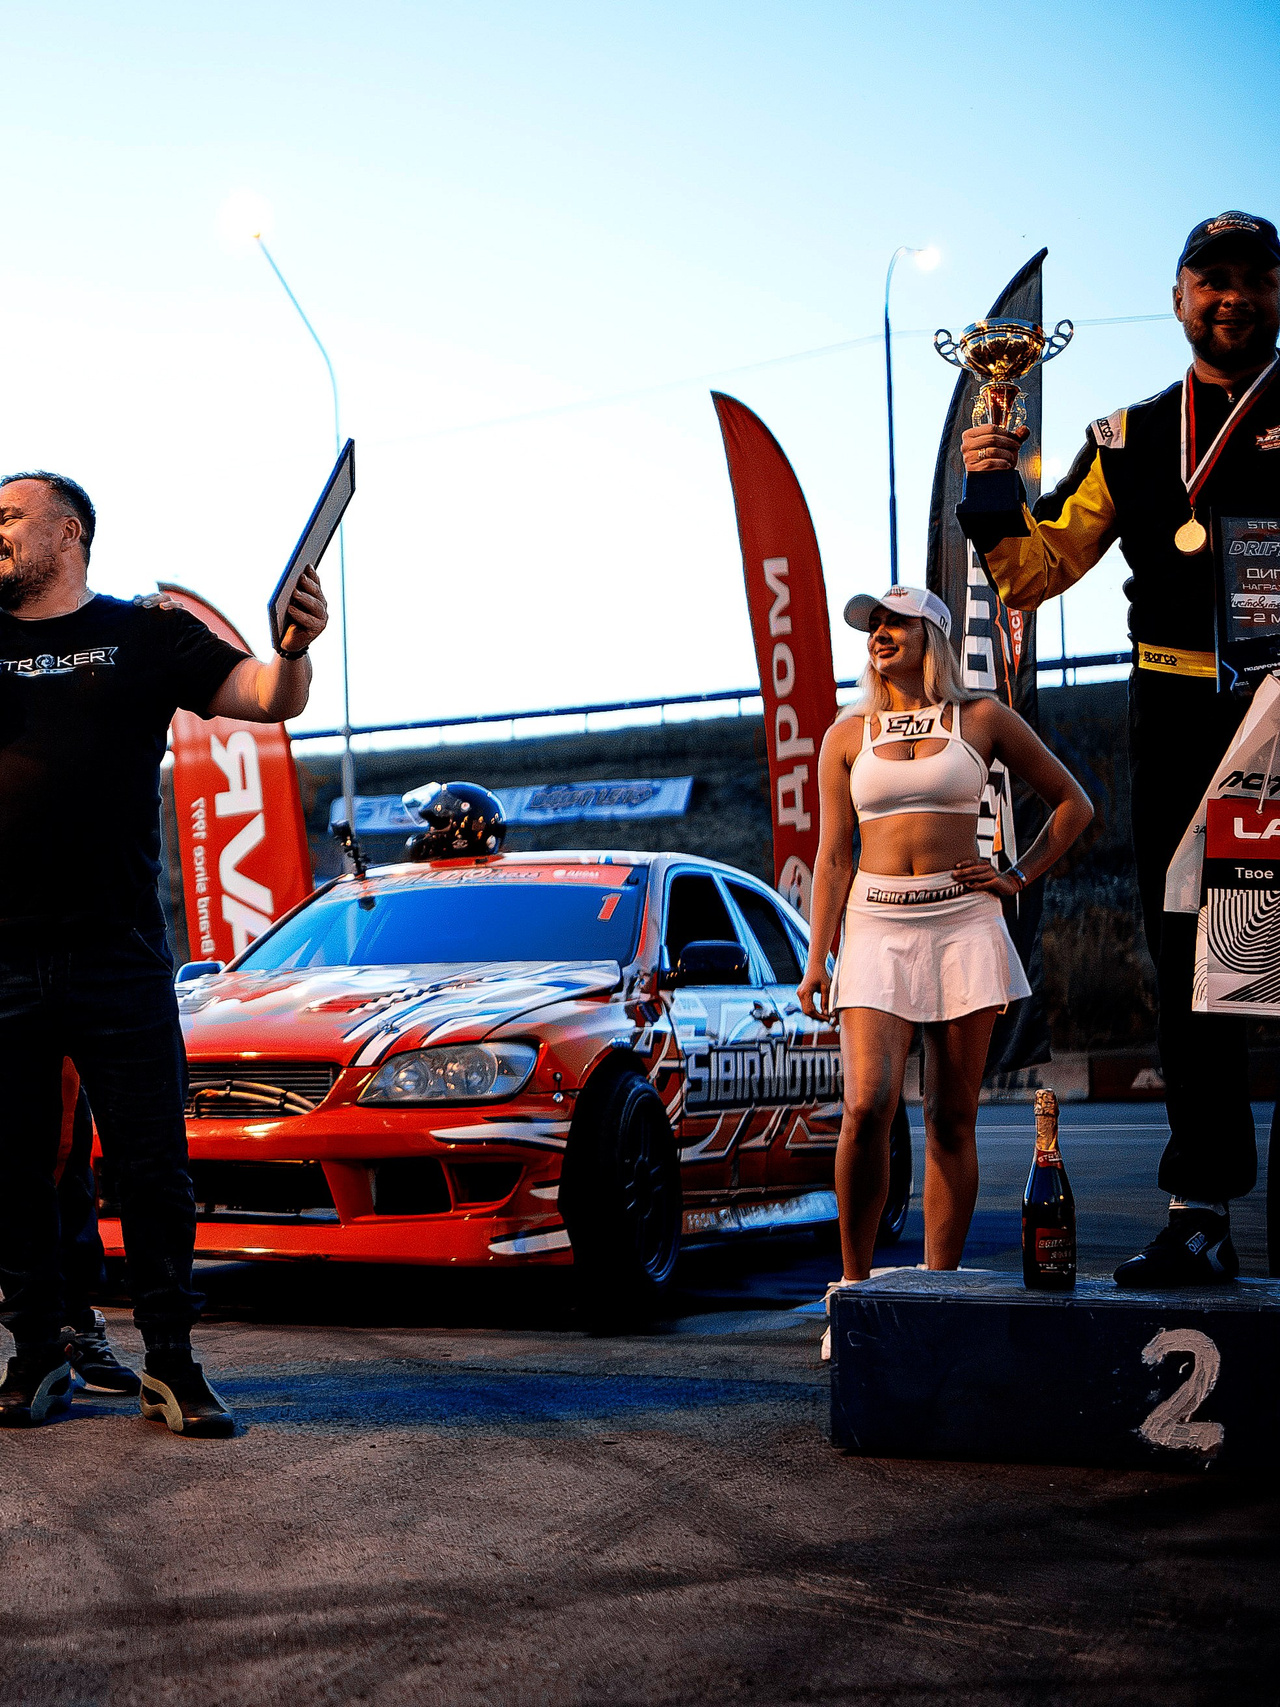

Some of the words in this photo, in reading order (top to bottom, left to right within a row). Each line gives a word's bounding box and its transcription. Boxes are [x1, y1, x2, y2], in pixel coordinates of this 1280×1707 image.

[1253, 613, 1266, 623] 2
[1010, 609, 1023, 656] RACI
[887, 716, 933, 737] SM
[1235, 867, 1274, 879] Твое
[597, 892, 622, 922] 1
[1137, 1327, 1226, 1453] 2
